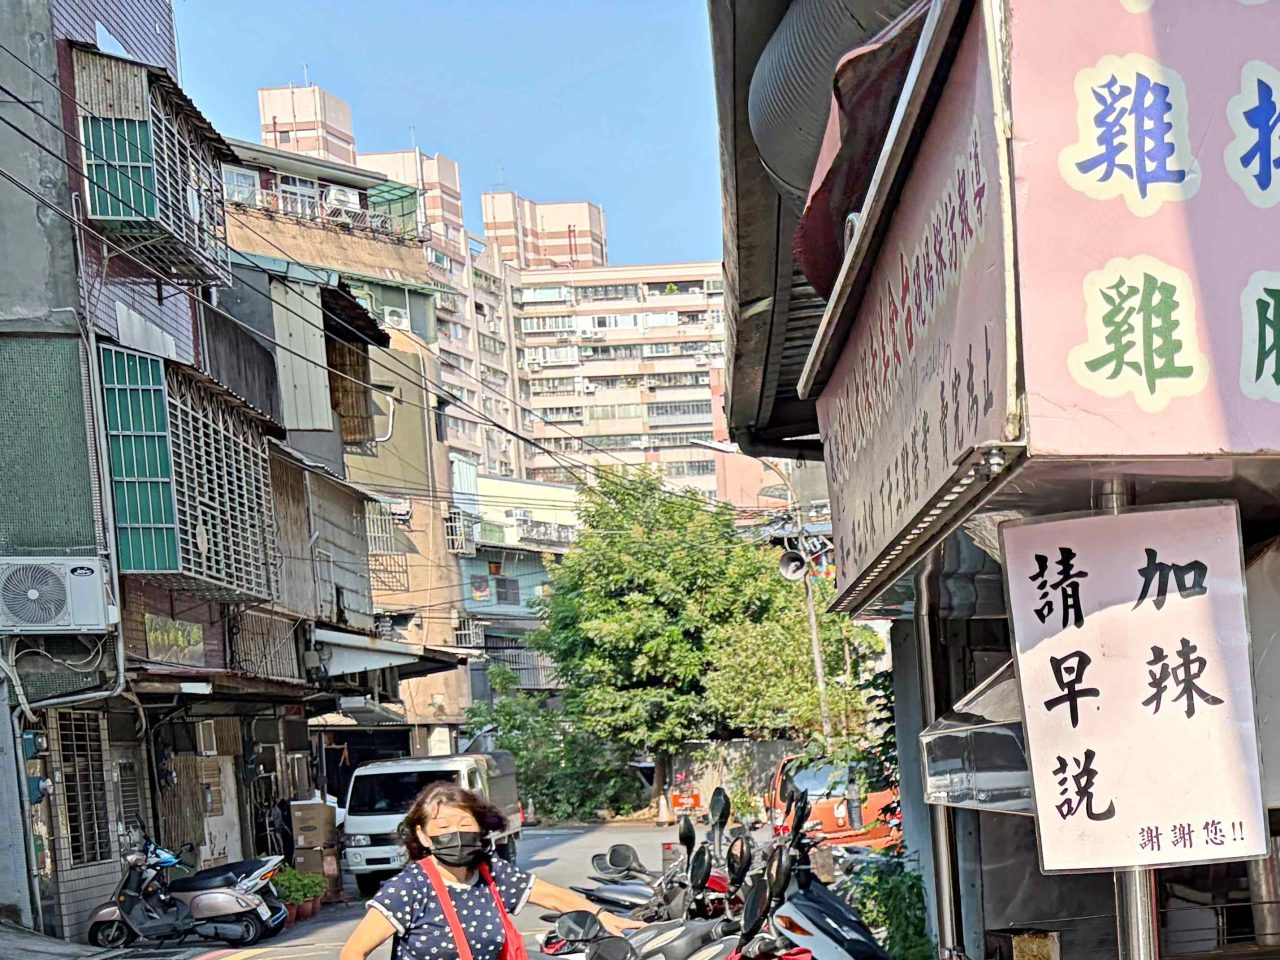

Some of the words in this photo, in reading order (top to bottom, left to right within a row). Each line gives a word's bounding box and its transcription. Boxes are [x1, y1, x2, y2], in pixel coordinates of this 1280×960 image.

[1029, 547, 1116, 821] 請早說
[1131, 547, 1225, 719] 加辣
